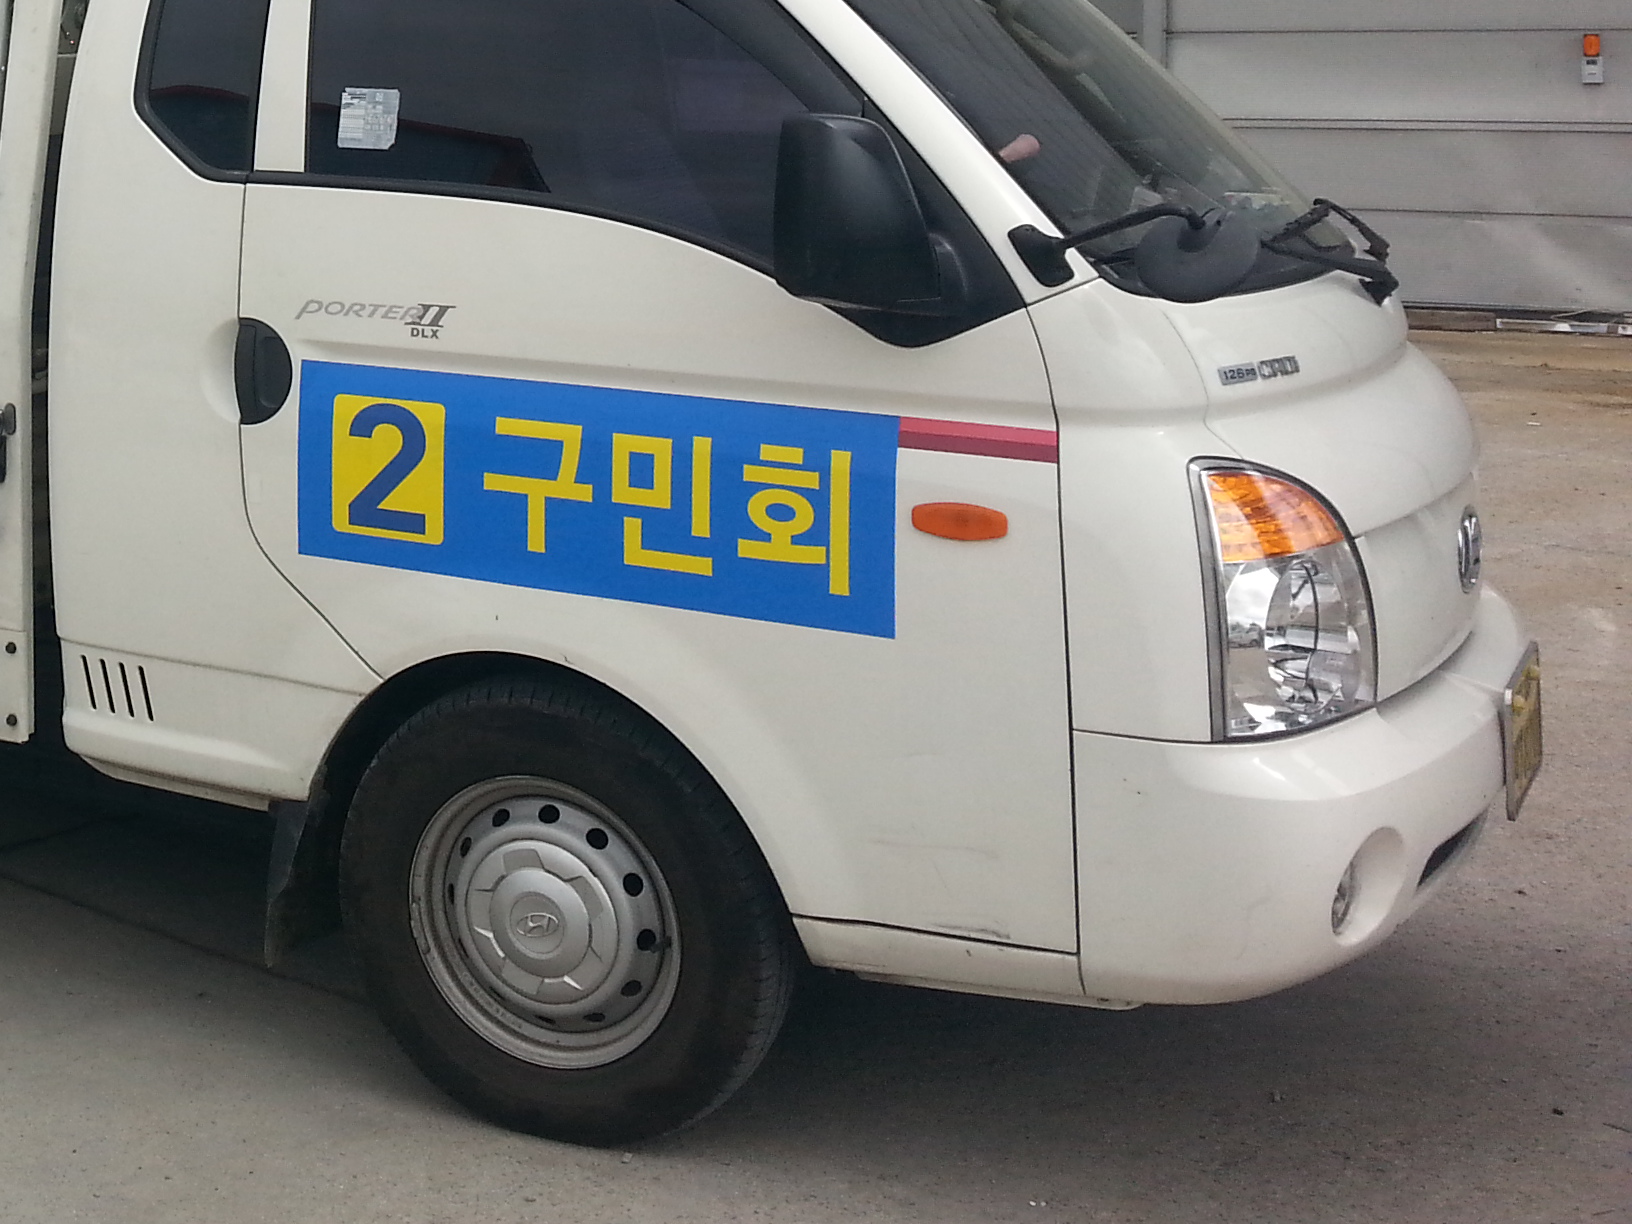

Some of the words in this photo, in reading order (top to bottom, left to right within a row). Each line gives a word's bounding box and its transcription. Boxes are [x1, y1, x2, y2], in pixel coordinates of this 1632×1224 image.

[294, 299, 425, 322] PORTER
[410, 327, 440, 340] DLX
[347, 402, 428, 537] 2
[482, 416, 852, 597] 구민회
